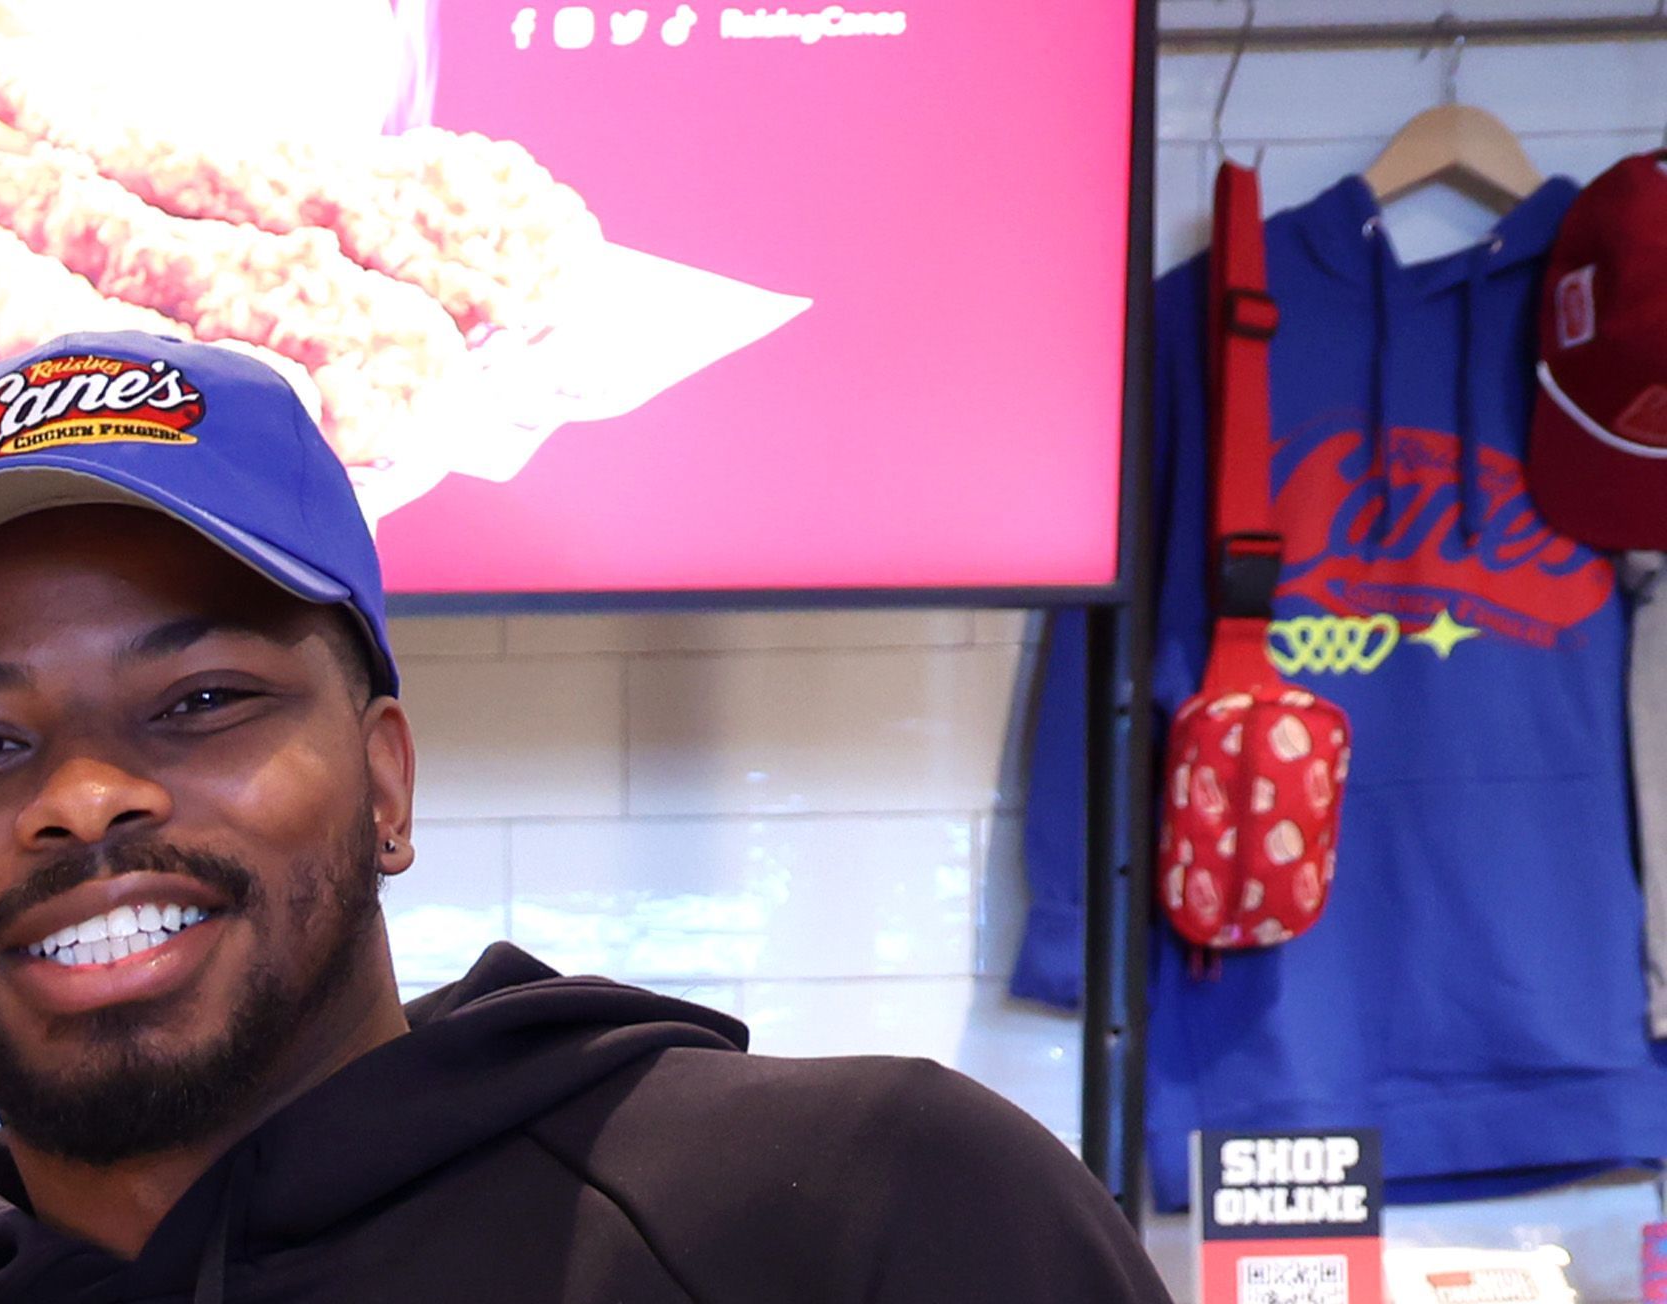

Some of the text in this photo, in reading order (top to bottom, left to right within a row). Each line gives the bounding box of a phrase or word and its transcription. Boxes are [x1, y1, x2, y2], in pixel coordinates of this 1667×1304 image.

[29, 354, 123, 383] Raising
[13, 423, 95, 450] CHICKEN
[1221, 1136, 1359, 1184] SHOP
[1213, 1185, 1367, 1226] ONLINE
